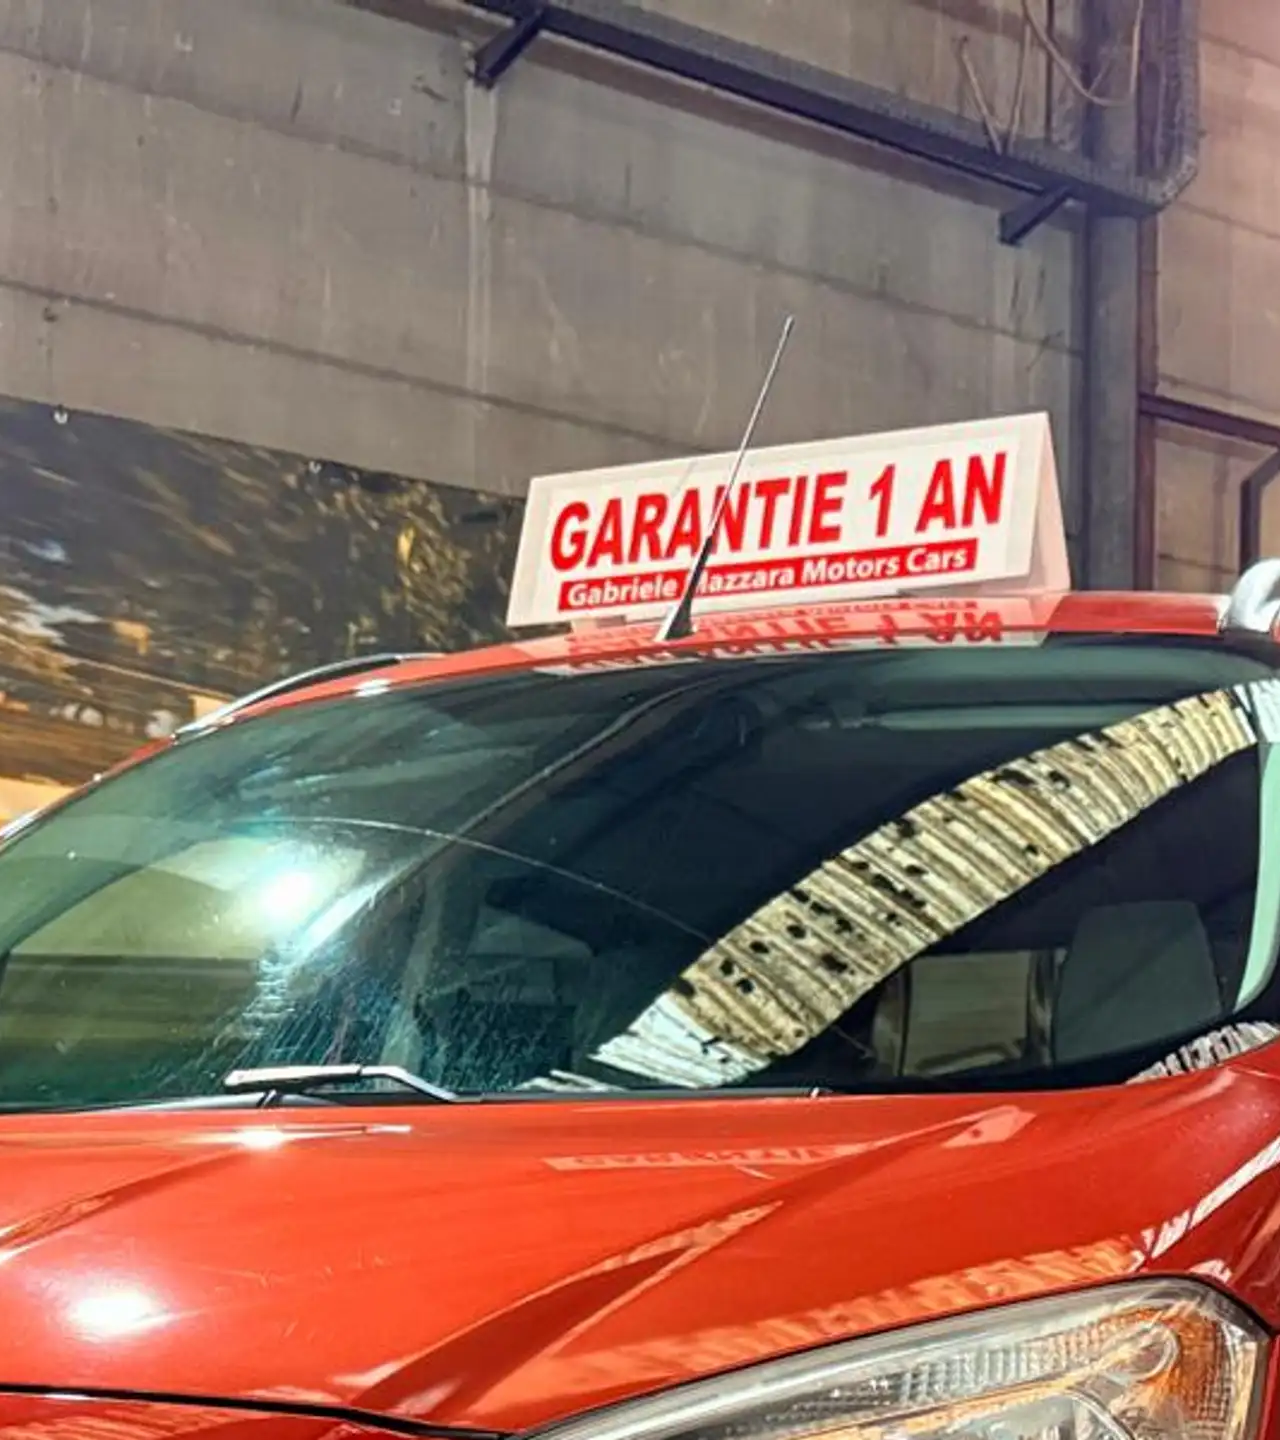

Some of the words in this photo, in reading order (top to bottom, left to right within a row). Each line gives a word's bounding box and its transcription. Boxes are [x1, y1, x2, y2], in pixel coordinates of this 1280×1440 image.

[550, 471, 847, 572] GARANTIE
[869, 463, 895, 538] 1
[915, 451, 1007, 534] AN
[568, 573, 678, 606] Gabriele
[801, 556, 900, 584] Motors
[906, 547, 968, 573] Cars
